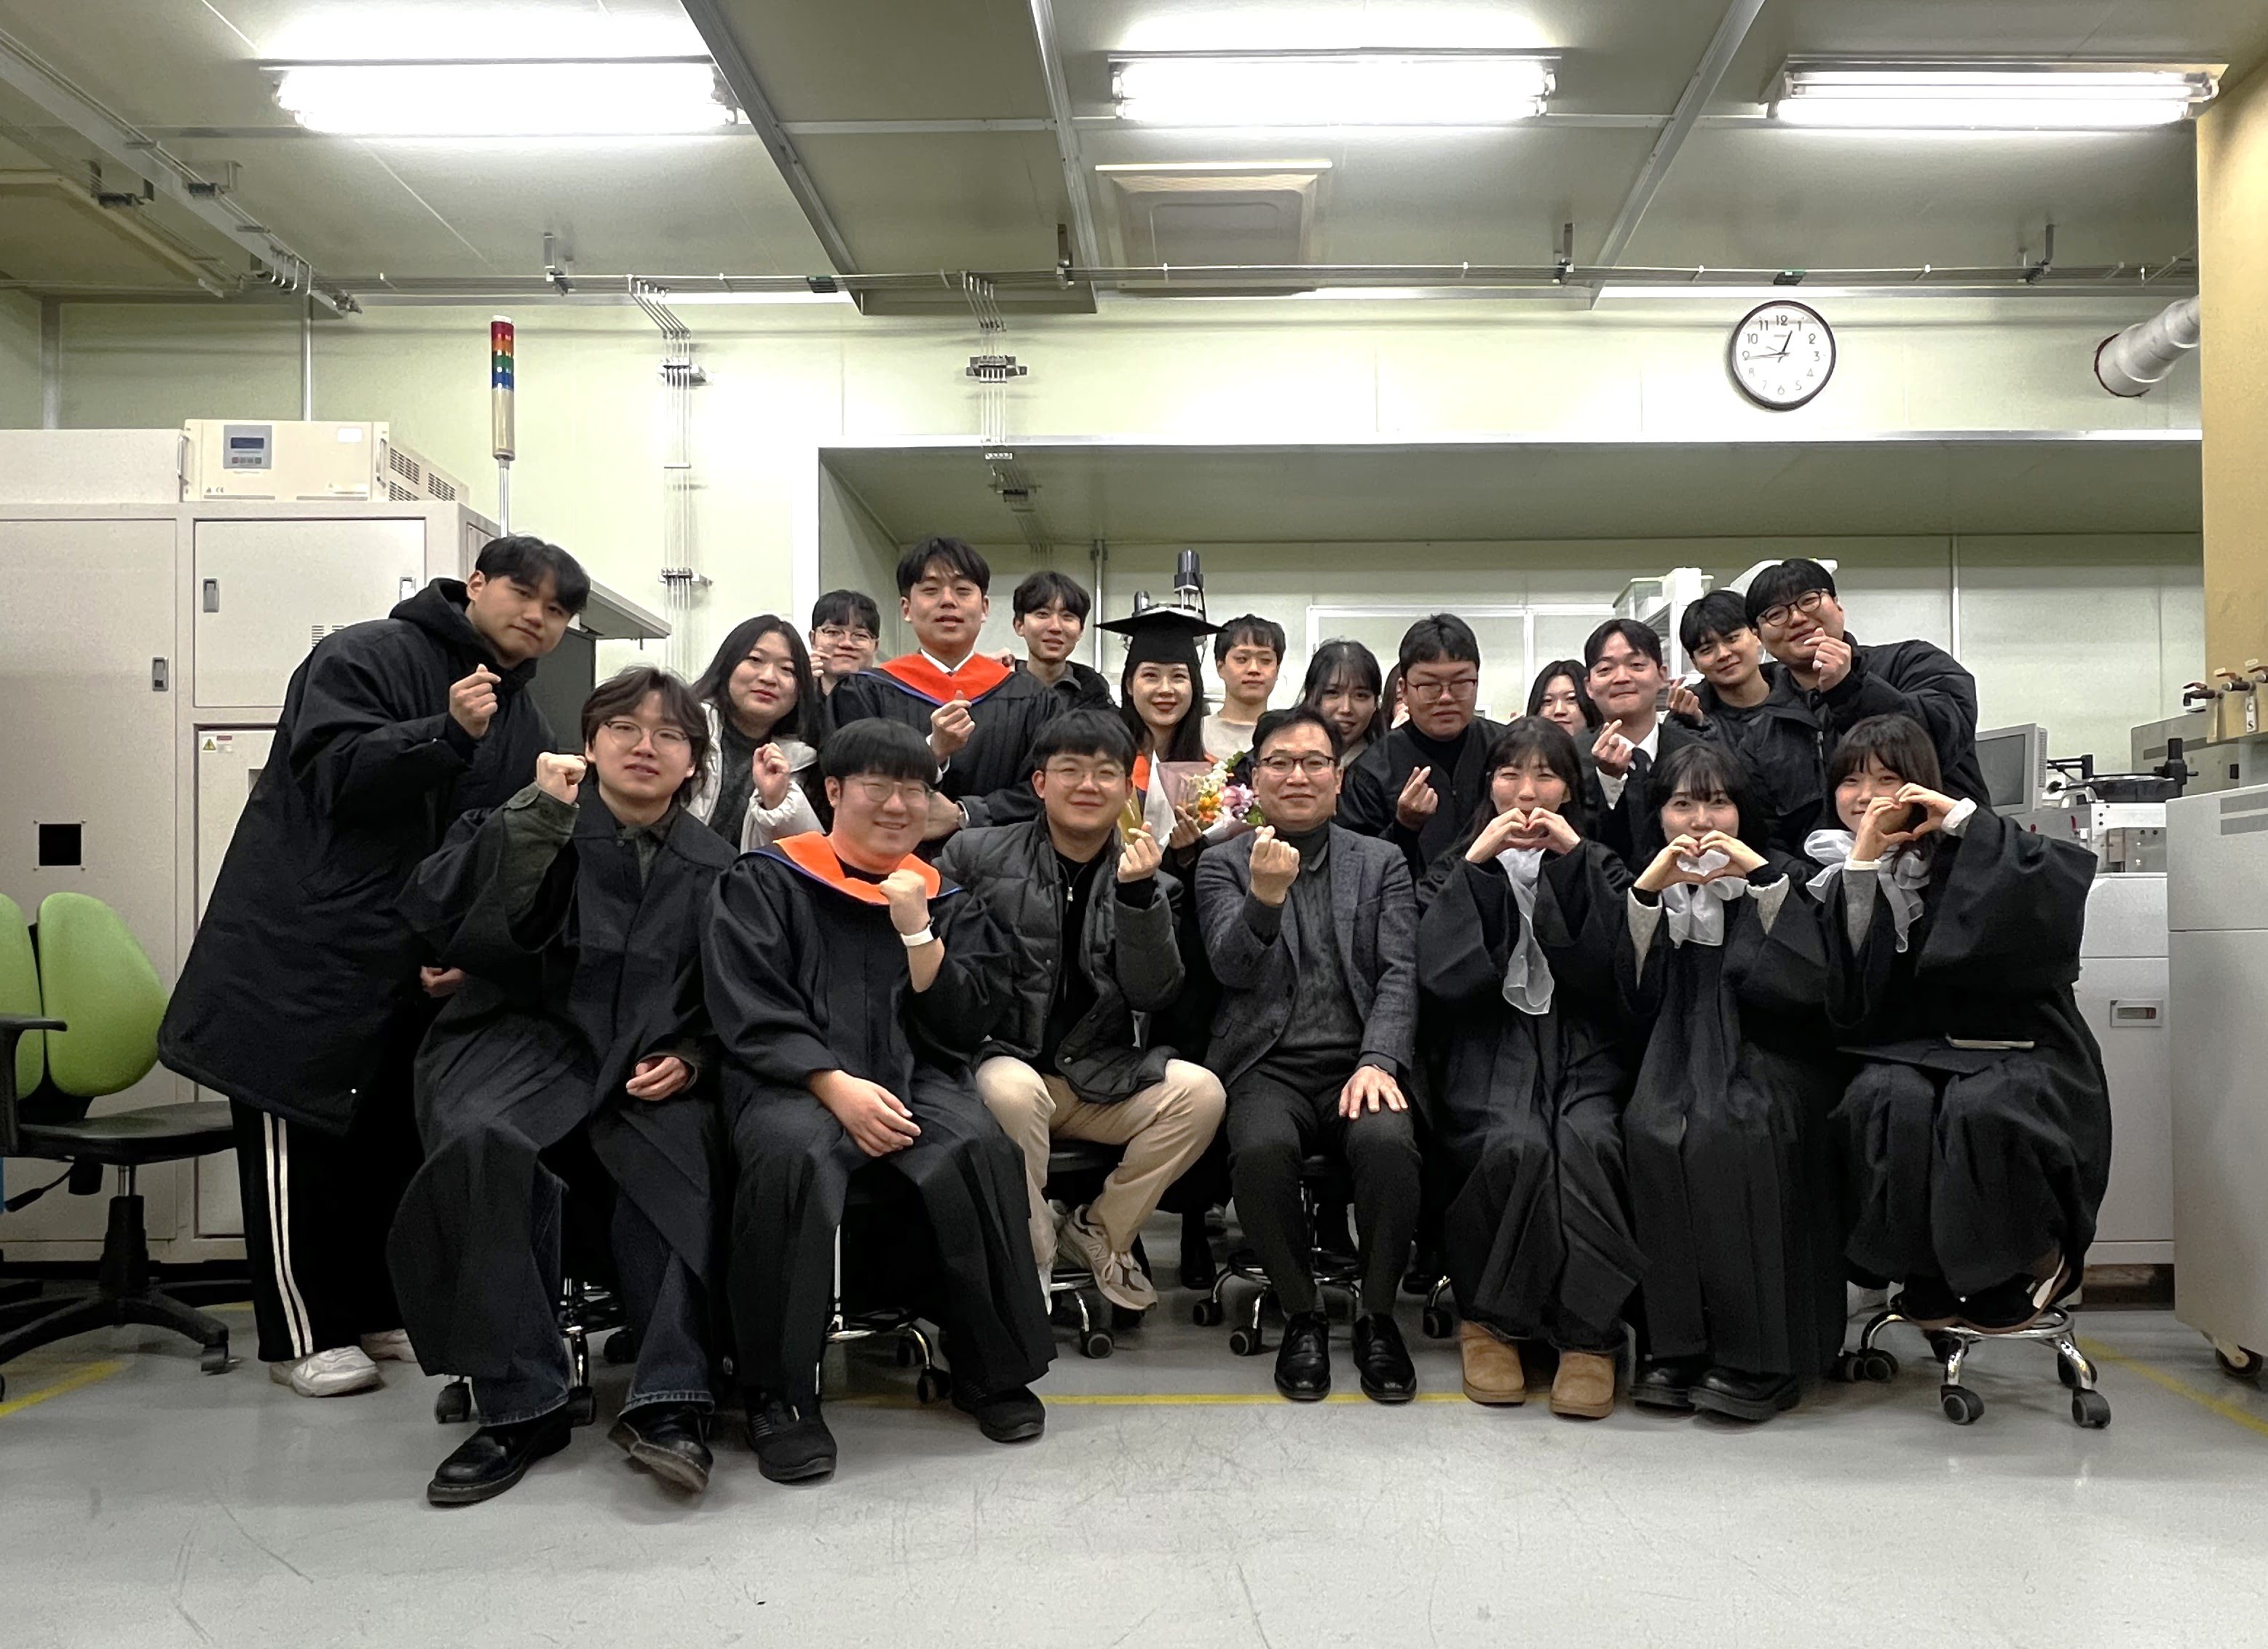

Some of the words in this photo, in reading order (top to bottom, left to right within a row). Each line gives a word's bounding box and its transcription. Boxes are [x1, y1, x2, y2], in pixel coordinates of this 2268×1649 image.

[1759, 320, 1769, 331] 11
[1775, 315, 1788, 326] 12
[1798, 320, 1801, 331] 1
[1747, 333, 1758, 344] 10
[1809, 333, 1815, 344] 2
[1742, 351, 1750, 360] 9
[1814, 351, 1820, 362] 3
[1806, 368, 1814, 376] 4
[1762, 380, 1767, 390] 7
[1777, 385, 1785, 395] 6
[1795, 380, 1802, 391] 5
[1088, 1242, 1108, 1262] N
